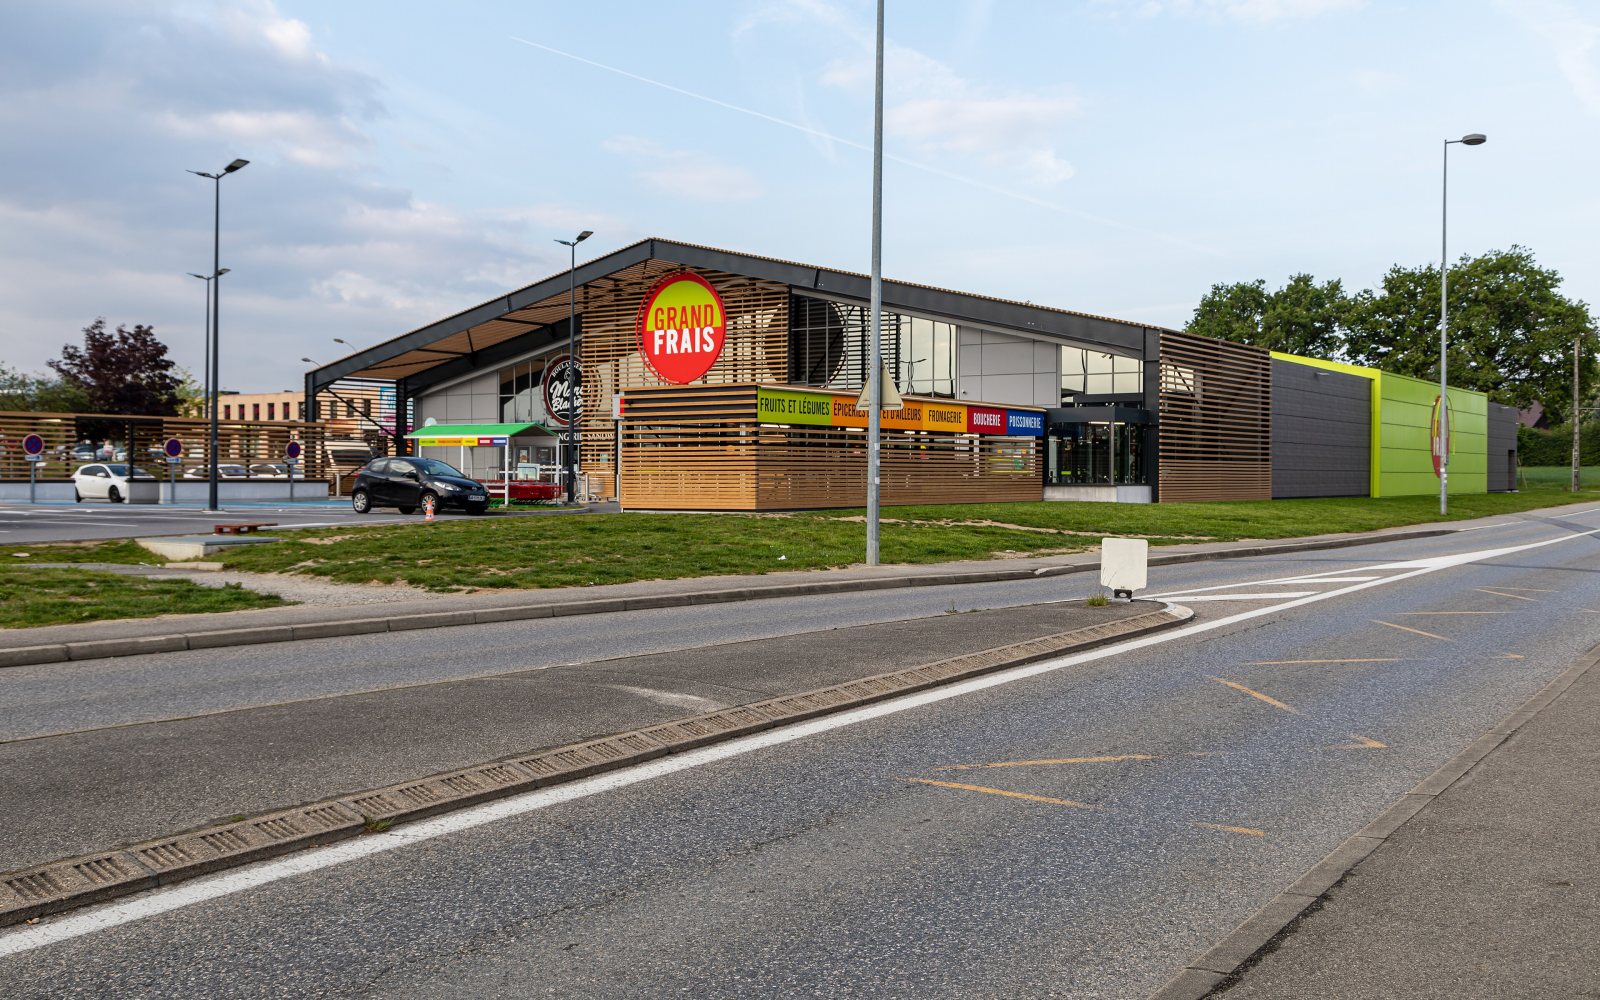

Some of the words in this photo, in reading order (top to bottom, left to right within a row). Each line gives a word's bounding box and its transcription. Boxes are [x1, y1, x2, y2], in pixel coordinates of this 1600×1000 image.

[654, 304, 714, 330] GRAND
[654, 326, 715, 355] FRAIS
[760, 397, 786, 413] FRUITS
[788, 400, 797, 414] ET
[799, 397, 830, 416] LÉGUMES
[928, 409, 962, 424] FROMAGERIE
[973, 412, 1001, 427] BOUCHERIE
[1008, 415, 1041, 429] POISSONNERIE
